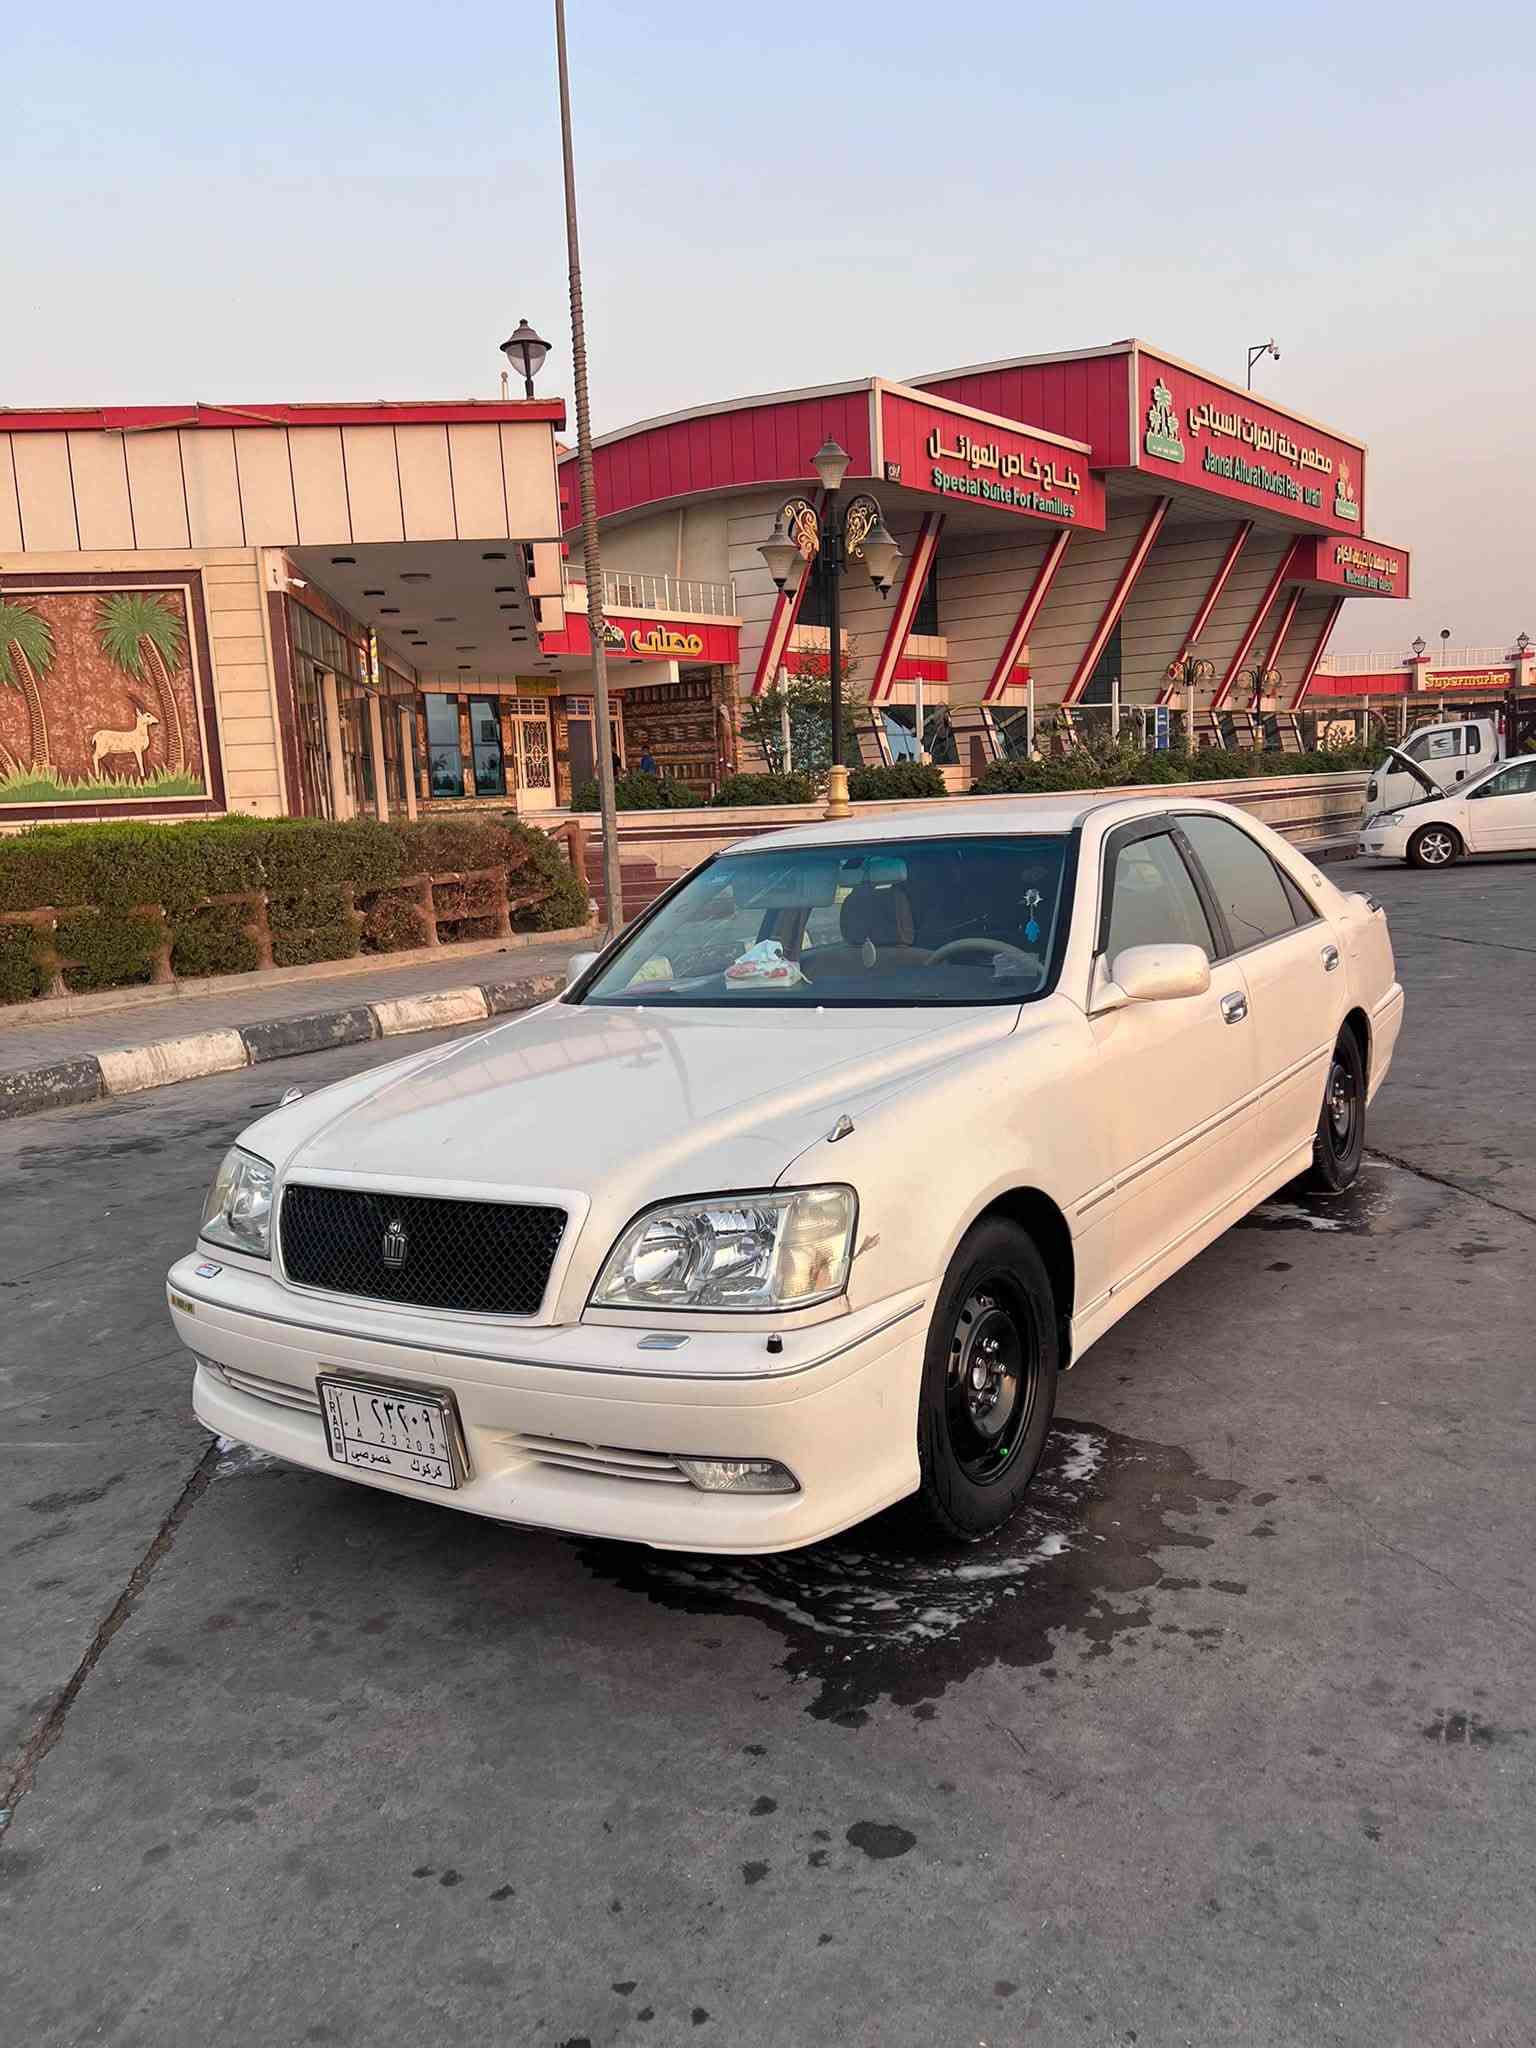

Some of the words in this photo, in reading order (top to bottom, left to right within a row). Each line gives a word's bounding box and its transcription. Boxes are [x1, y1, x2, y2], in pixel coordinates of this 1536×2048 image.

[1189, 404, 1240, 437] السياحي
[1242, 418, 1277, 452] الفرات
[929, 427, 999, 469] للعوائل
[1279, 433, 1298, 466] جنة
[1300, 447, 1333, 474] مطعم
[1001, 453, 1040, 479] خاص
[1041, 462, 1080, 495] جناح
[1203, 447, 1233, 479] Jannat
[1261, 465, 1286, 496] Tourist
[932, 467, 980, 493] Special
[982, 479, 1015, 504] Suite
[1014, 487, 1031, 507] For
[1033, 491, 1074, 517] Families
[1425, 672, 1510, 689] Supermarket
[328, 1388, 341, 1440] IRAQ
[351, 1449, 392, 1464] خصوصي
[411, 1457, 443, 1480] كركوك
